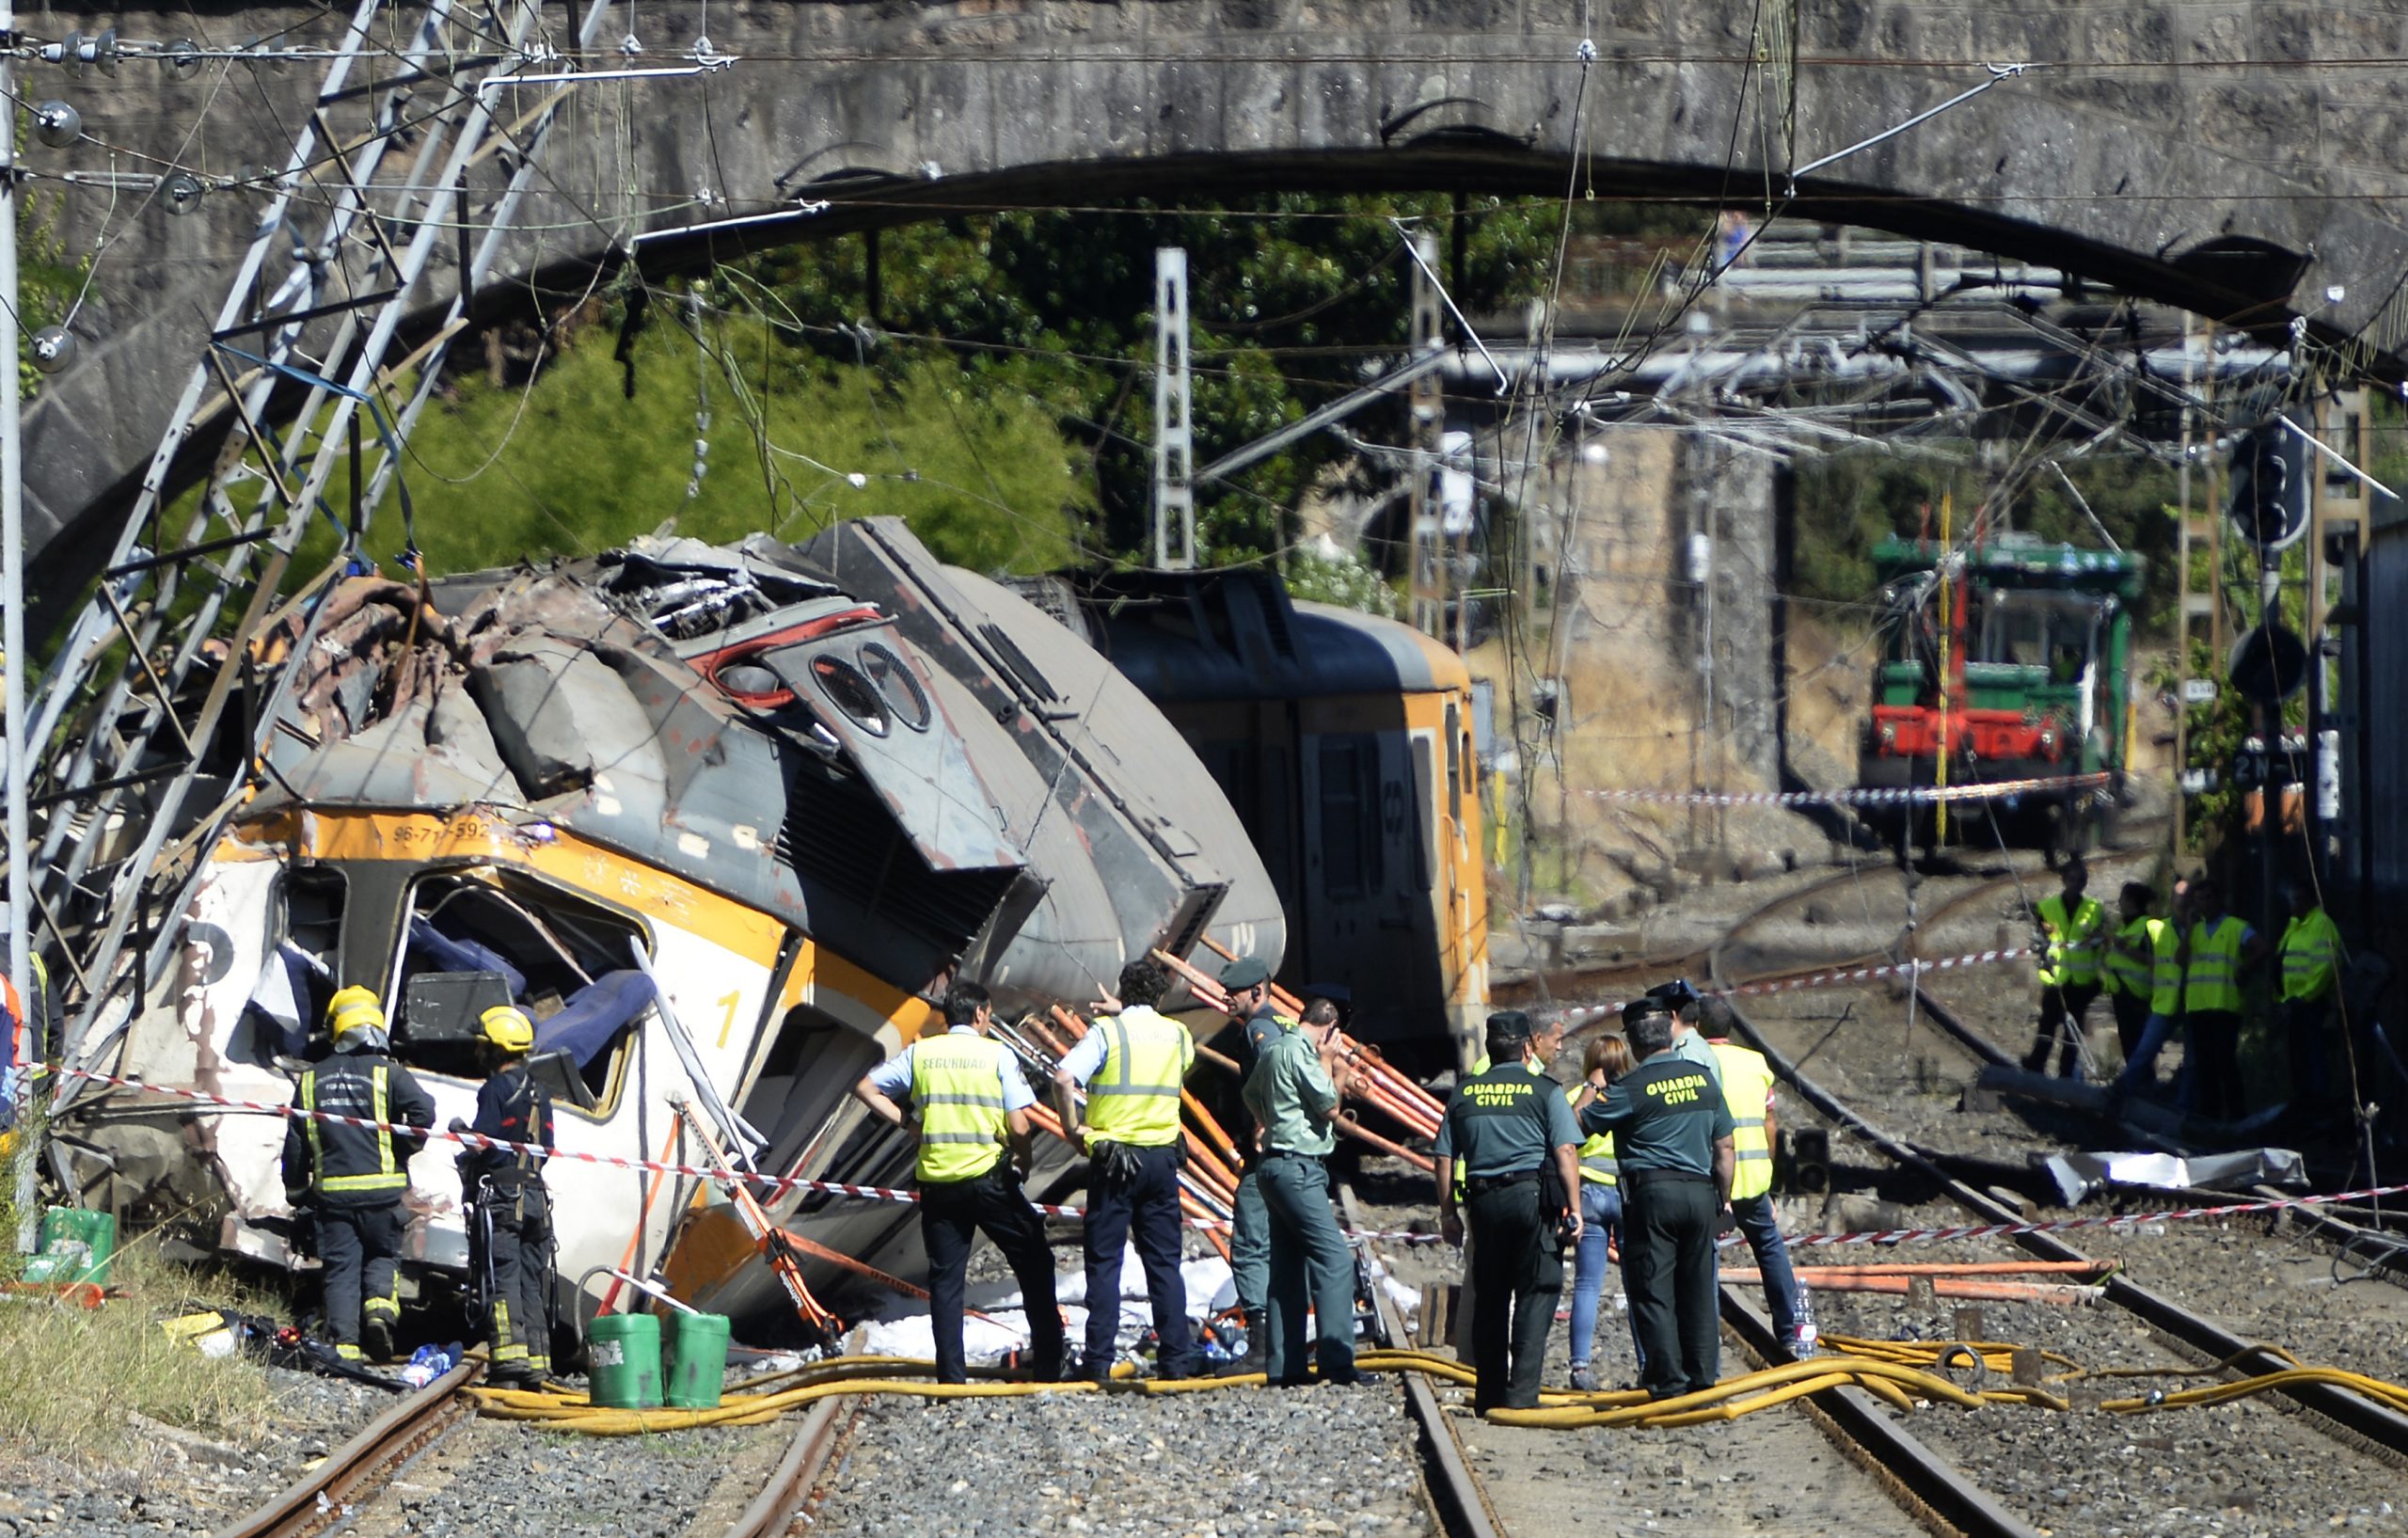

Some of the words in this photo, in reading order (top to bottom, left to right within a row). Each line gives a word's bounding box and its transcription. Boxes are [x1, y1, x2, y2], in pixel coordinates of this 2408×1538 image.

[716, 989, 740, 1050] 1
[923, 1057, 987, 1070] SEGURIDAD
[1463, 1083, 1533, 1096] GUARDIA
[1646, 1074, 1707, 1096] GUARDIA
[1476, 1094, 1514, 1106] CIVIL
[1664, 1088, 1699, 1105] CIVIL
